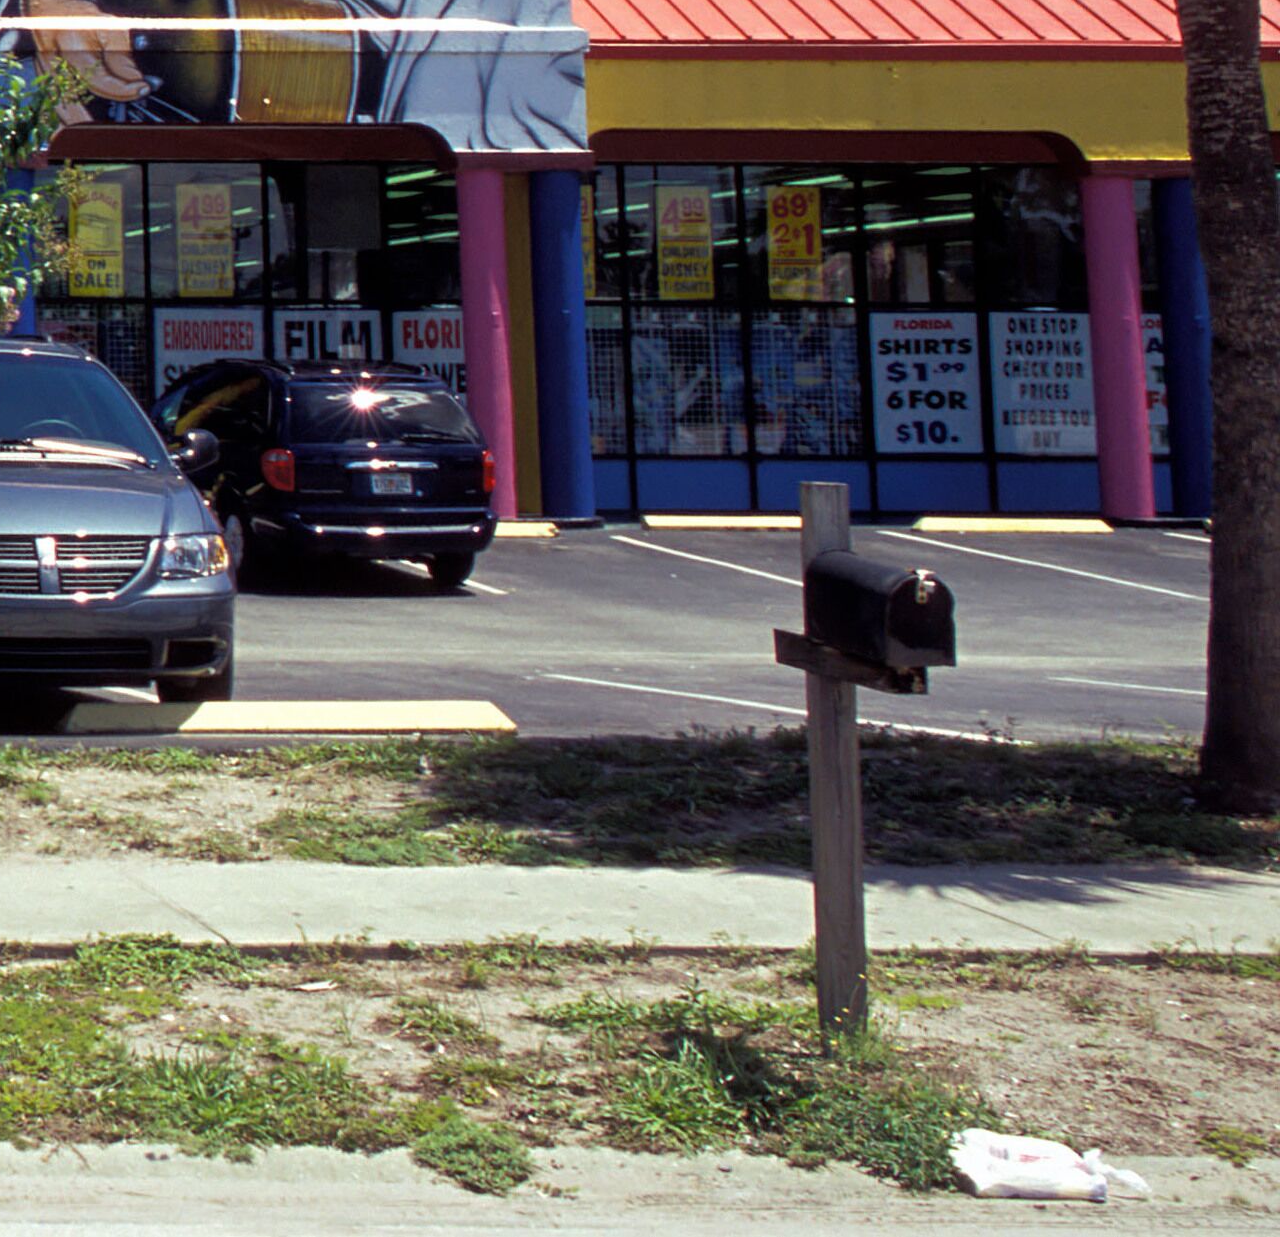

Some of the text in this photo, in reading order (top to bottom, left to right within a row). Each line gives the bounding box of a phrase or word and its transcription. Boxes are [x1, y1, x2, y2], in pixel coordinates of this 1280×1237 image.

[87, 259, 107, 270] ON
[662, 263, 710, 277] DISNEY
[74, 273, 120, 289] SALE!
[402, 318, 461, 349] FLORI
[893, 318, 954, 331] FLORIDA
[1008, 317, 1079, 335] ONE STOP
[163, 319, 254, 351] EMBROIDERED
[285, 320, 372, 361] FILM
[877, 338, 973, 356] SHIRTS
[1005, 339, 1083, 357] SHOPPING
[1002, 361, 1084, 380] CHECK OUR
[886, 390, 968, 411] 6 FOR
[1019, 383, 1070, 401] PRICES
[1002, 409, 1090, 427] BEFORE YOU
[1032, 430, 1062, 449] BUY
